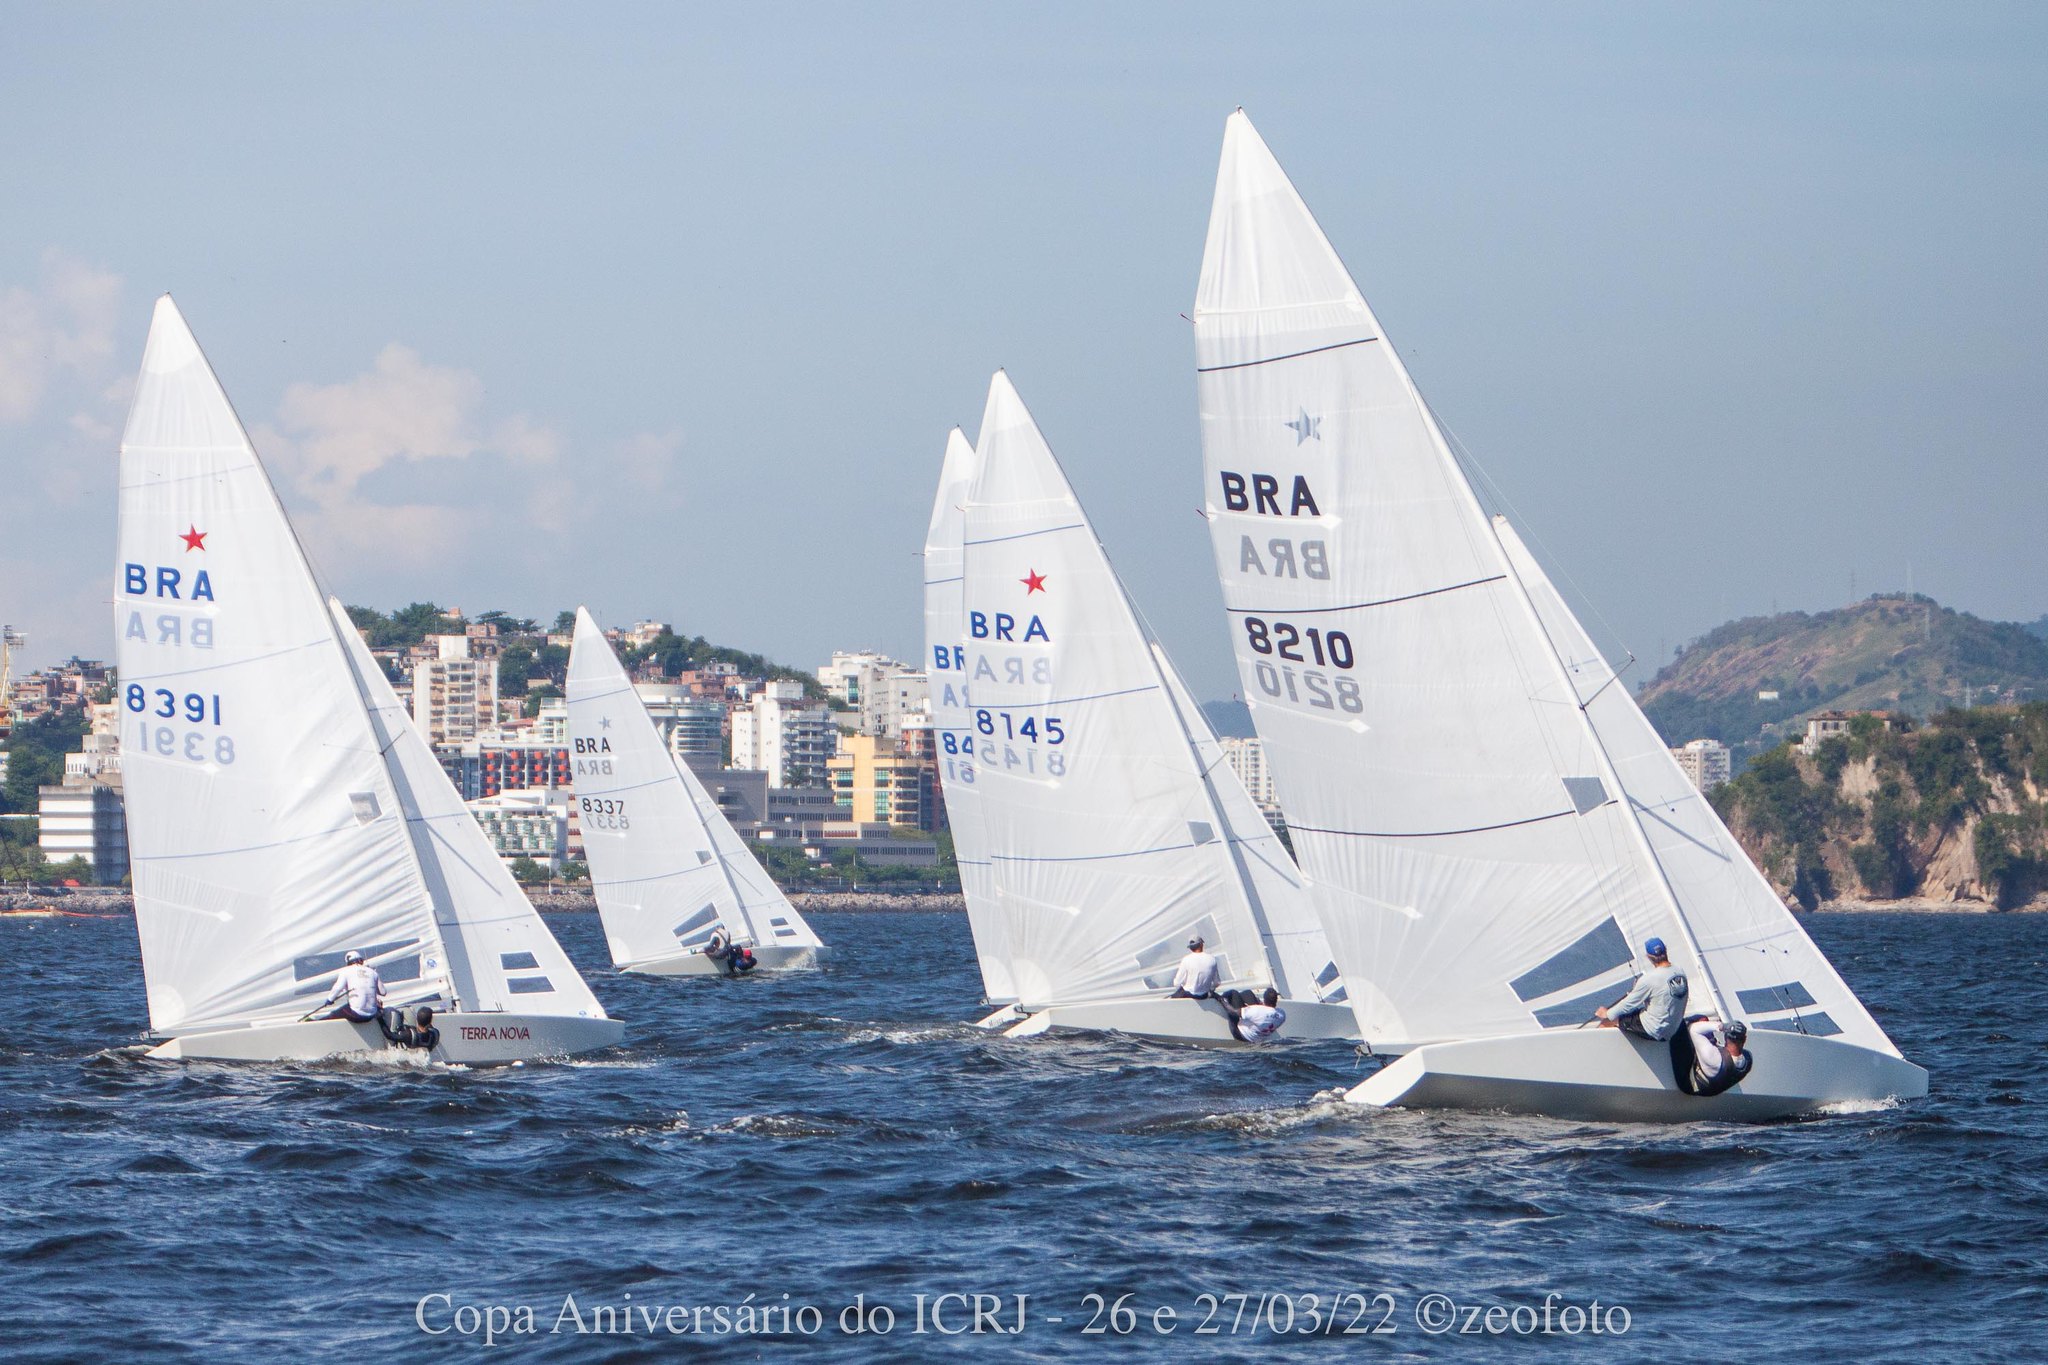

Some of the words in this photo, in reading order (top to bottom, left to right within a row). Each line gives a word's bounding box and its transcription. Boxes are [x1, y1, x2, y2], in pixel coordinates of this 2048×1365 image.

[1220, 470, 1321, 516] BRA
[124, 562, 215, 602] BRA
[970, 610, 1050, 642] BRA
[1244, 616, 1354, 669] 8210
[934, 645, 966, 671] BR
[126, 683, 221, 725] 8391
[976, 709, 1065, 745] 8145
[575, 737, 612, 753] BRA
[582, 797, 624, 815] 8337
[460, 1026, 497, 1040] TERRA
[500, 1026, 530, 1040] NOVA
